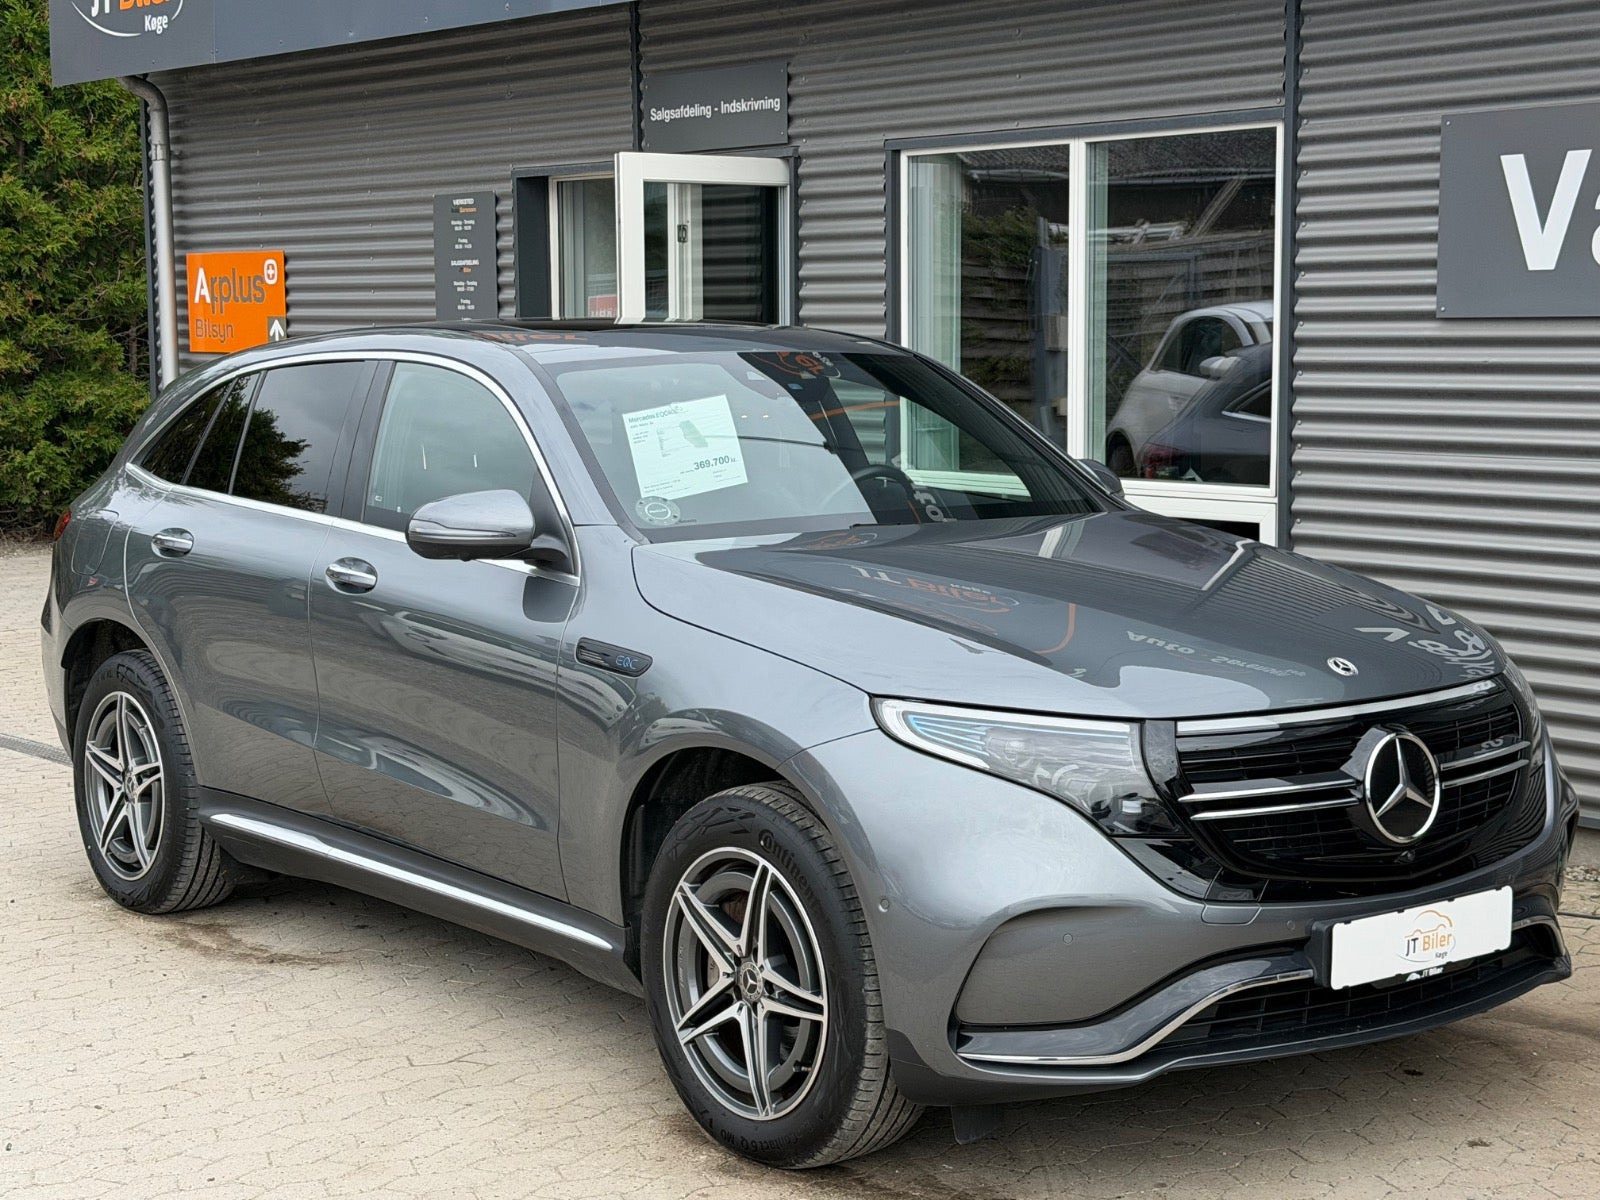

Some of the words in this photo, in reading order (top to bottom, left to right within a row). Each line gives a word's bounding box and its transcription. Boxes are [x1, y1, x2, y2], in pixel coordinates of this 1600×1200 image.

[144, 14, 168, 34] Køge
[650, 103, 712, 122] Salgsafdeling
[721, 96, 780, 114] Indskrivning
[1500, 149, 1600, 271] V
[195, 318, 234, 343] Bilsyn
[694, 455, 730, 471] 369.700
[615, 655, 639, 669] EQC
[1406, 937, 1419, 957] JT
[1423, 932, 1452, 951] Biler
